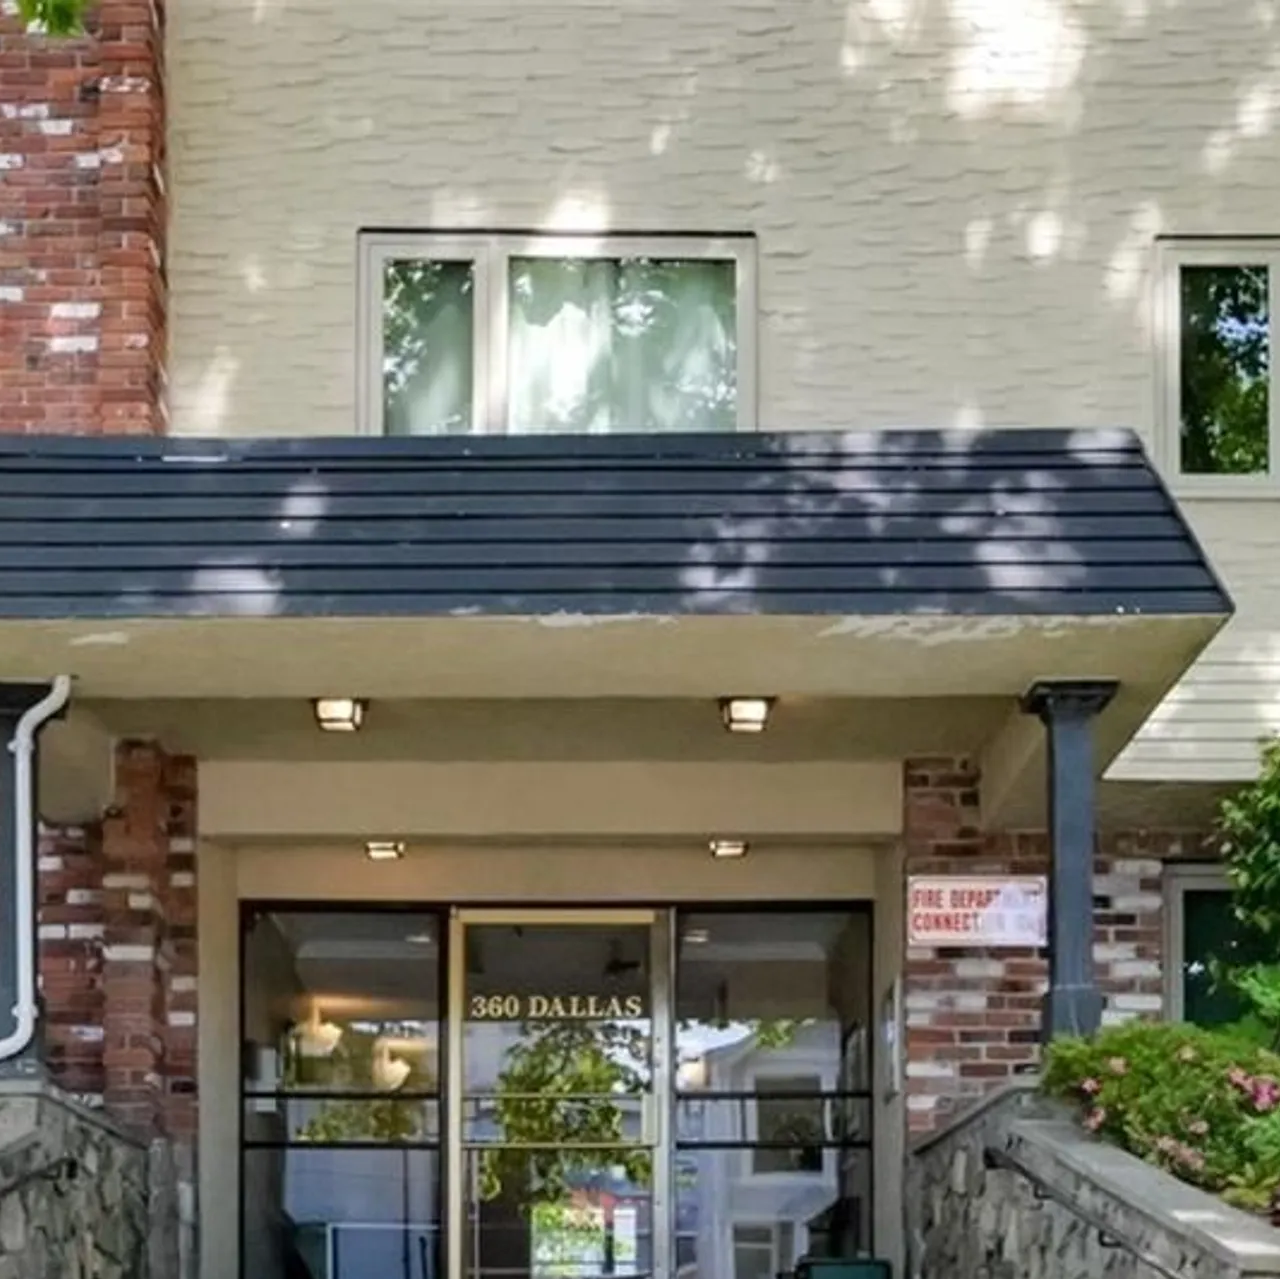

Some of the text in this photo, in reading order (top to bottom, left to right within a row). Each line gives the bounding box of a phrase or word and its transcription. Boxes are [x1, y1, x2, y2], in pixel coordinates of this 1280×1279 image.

[912, 889, 944, 908] FIRE
[471, 995, 642, 1018] 360 DALLAS
